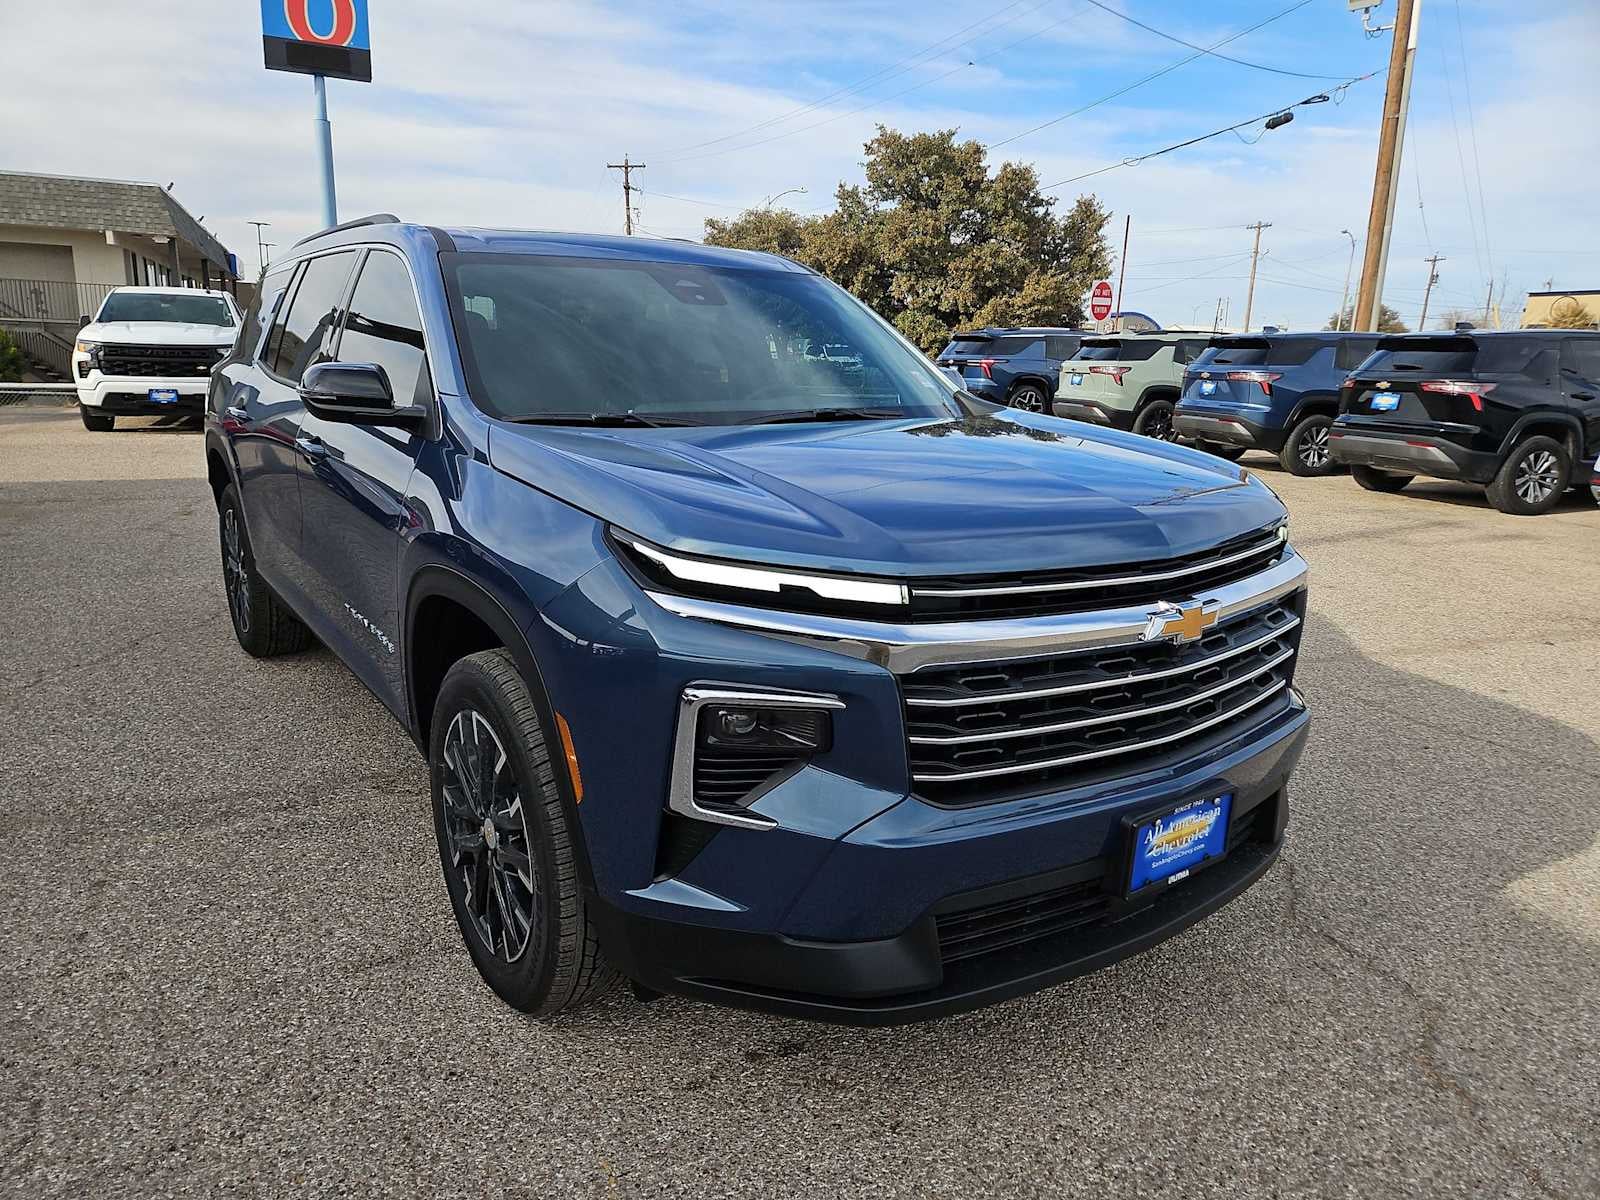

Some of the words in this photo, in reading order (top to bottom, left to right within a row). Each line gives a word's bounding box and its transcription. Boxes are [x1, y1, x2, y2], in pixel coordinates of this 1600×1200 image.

[1174, 803, 1193, 815] SINCE
[1144, 823, 1164, 844] All
[1168, 807, 1221, 833] American
[1151, 826, 1209, 857] Chevrolet
